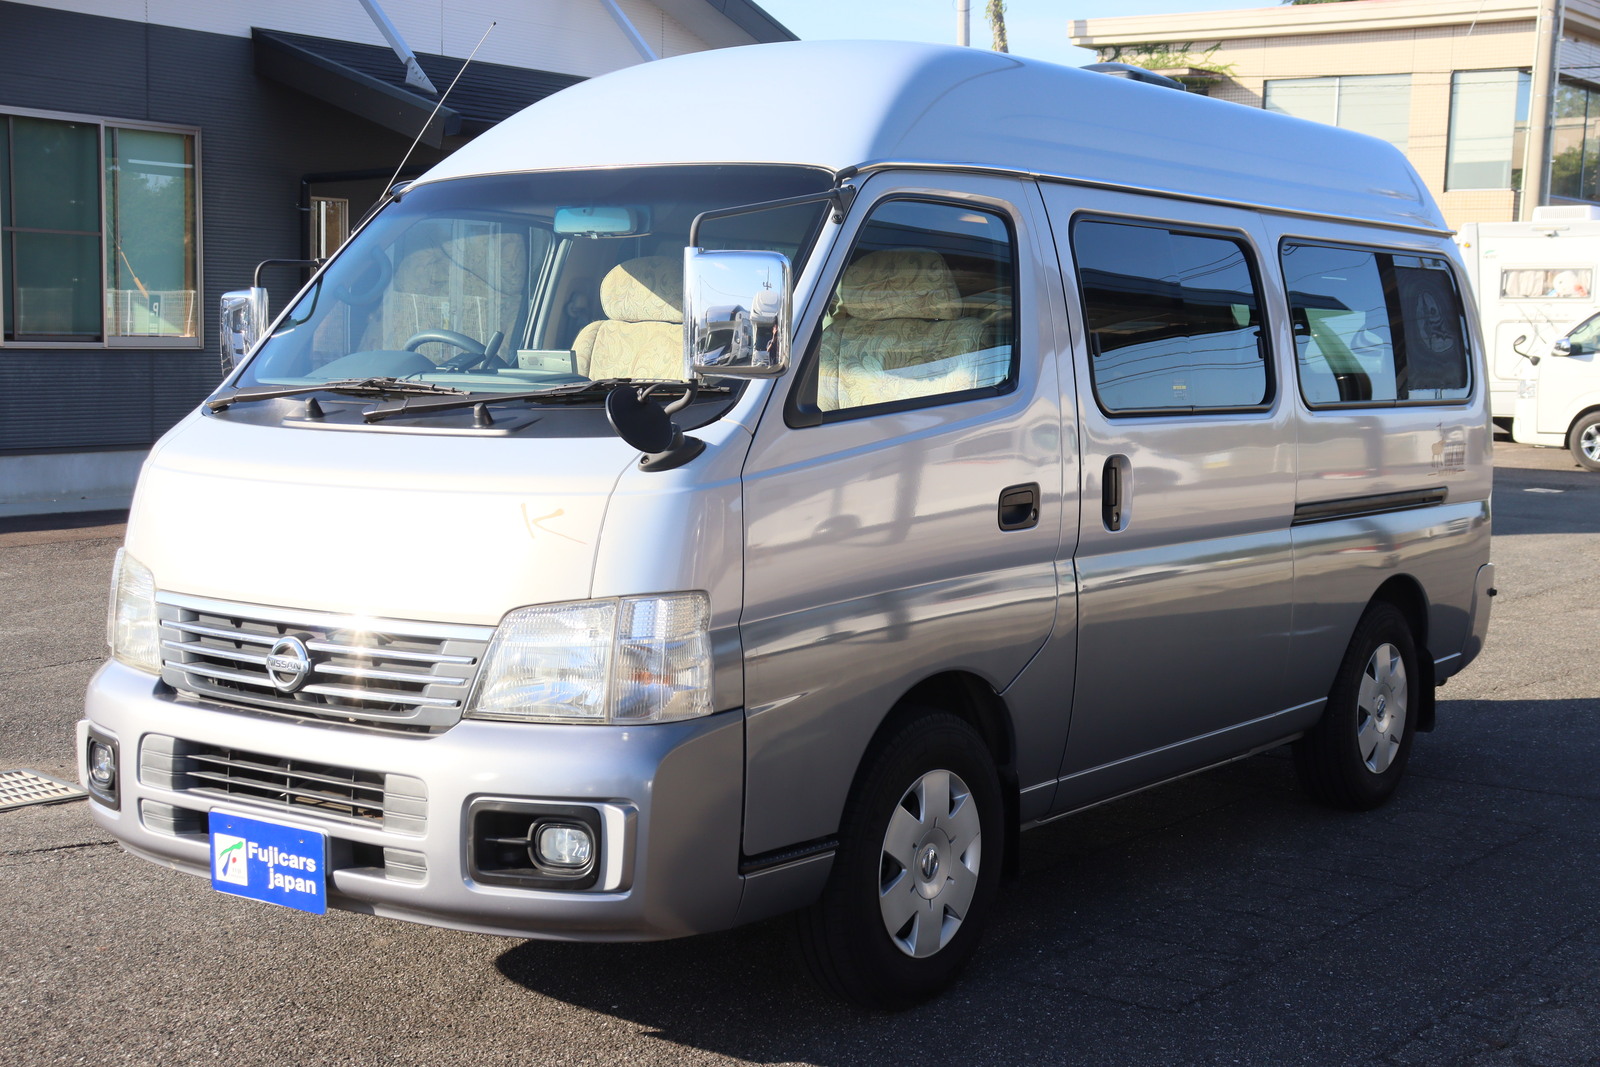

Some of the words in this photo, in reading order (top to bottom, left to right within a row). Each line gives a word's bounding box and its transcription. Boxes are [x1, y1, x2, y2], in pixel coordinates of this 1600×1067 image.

[268, 658, 302, 670] NISSAN
[247, 841, 317, 872] Fujicars
[268, 868, 317, 894] japan
